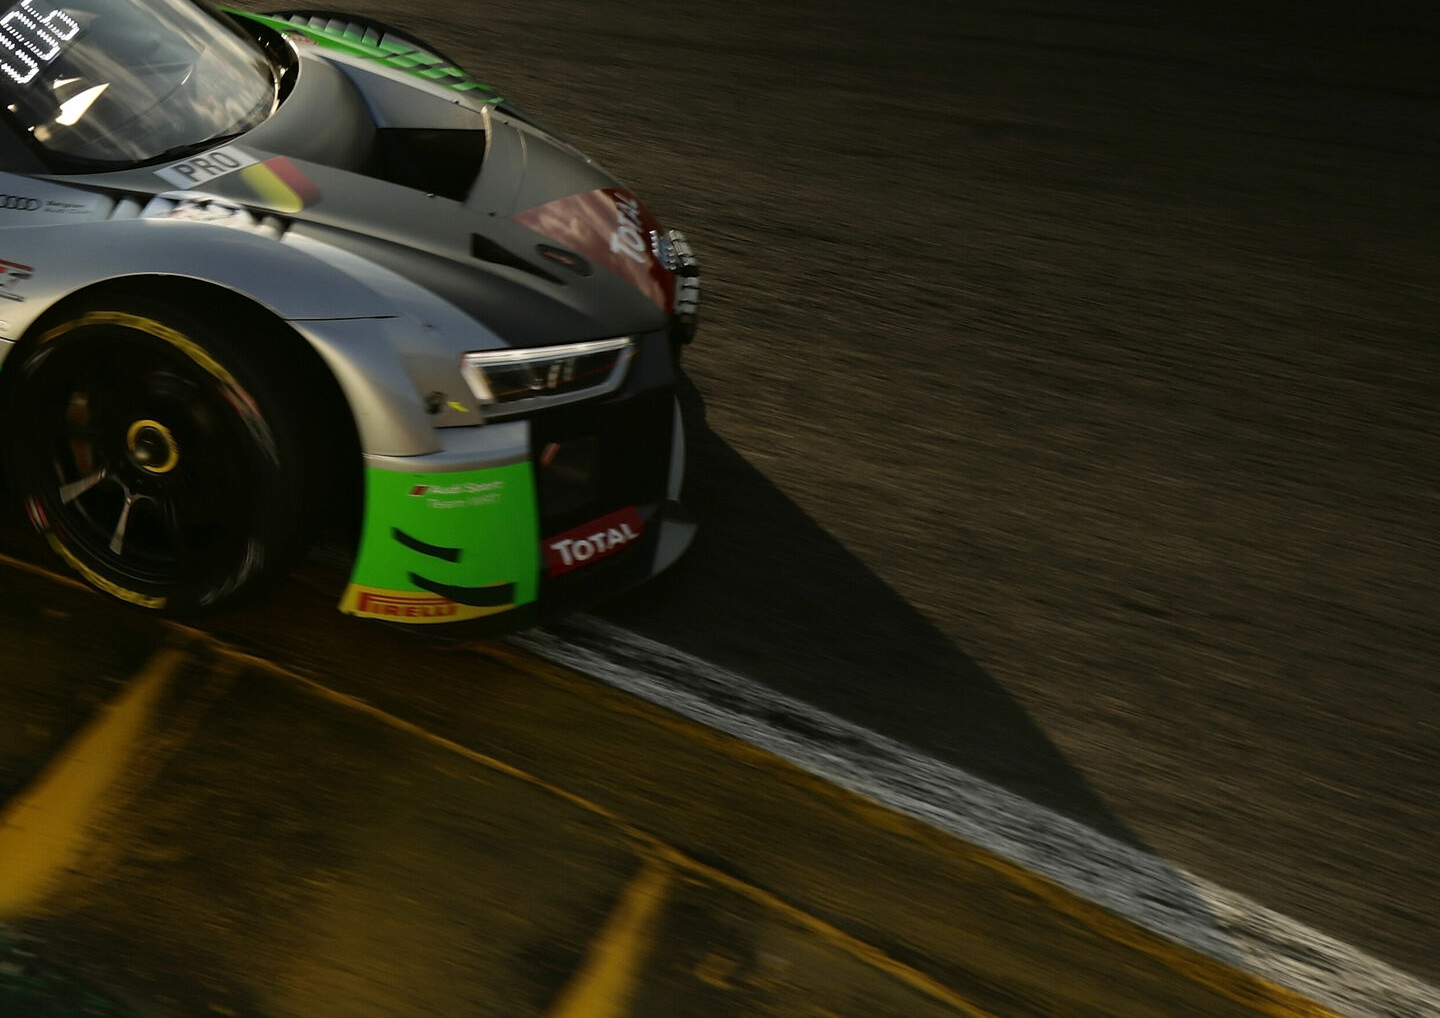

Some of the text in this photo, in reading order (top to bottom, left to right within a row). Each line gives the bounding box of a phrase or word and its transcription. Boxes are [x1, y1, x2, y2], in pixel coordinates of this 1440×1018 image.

[171, 152, 241, 183] PRO
[549, 523, 640, 567] TOTAL
[360, 593, 457, 617] PIRELLI
